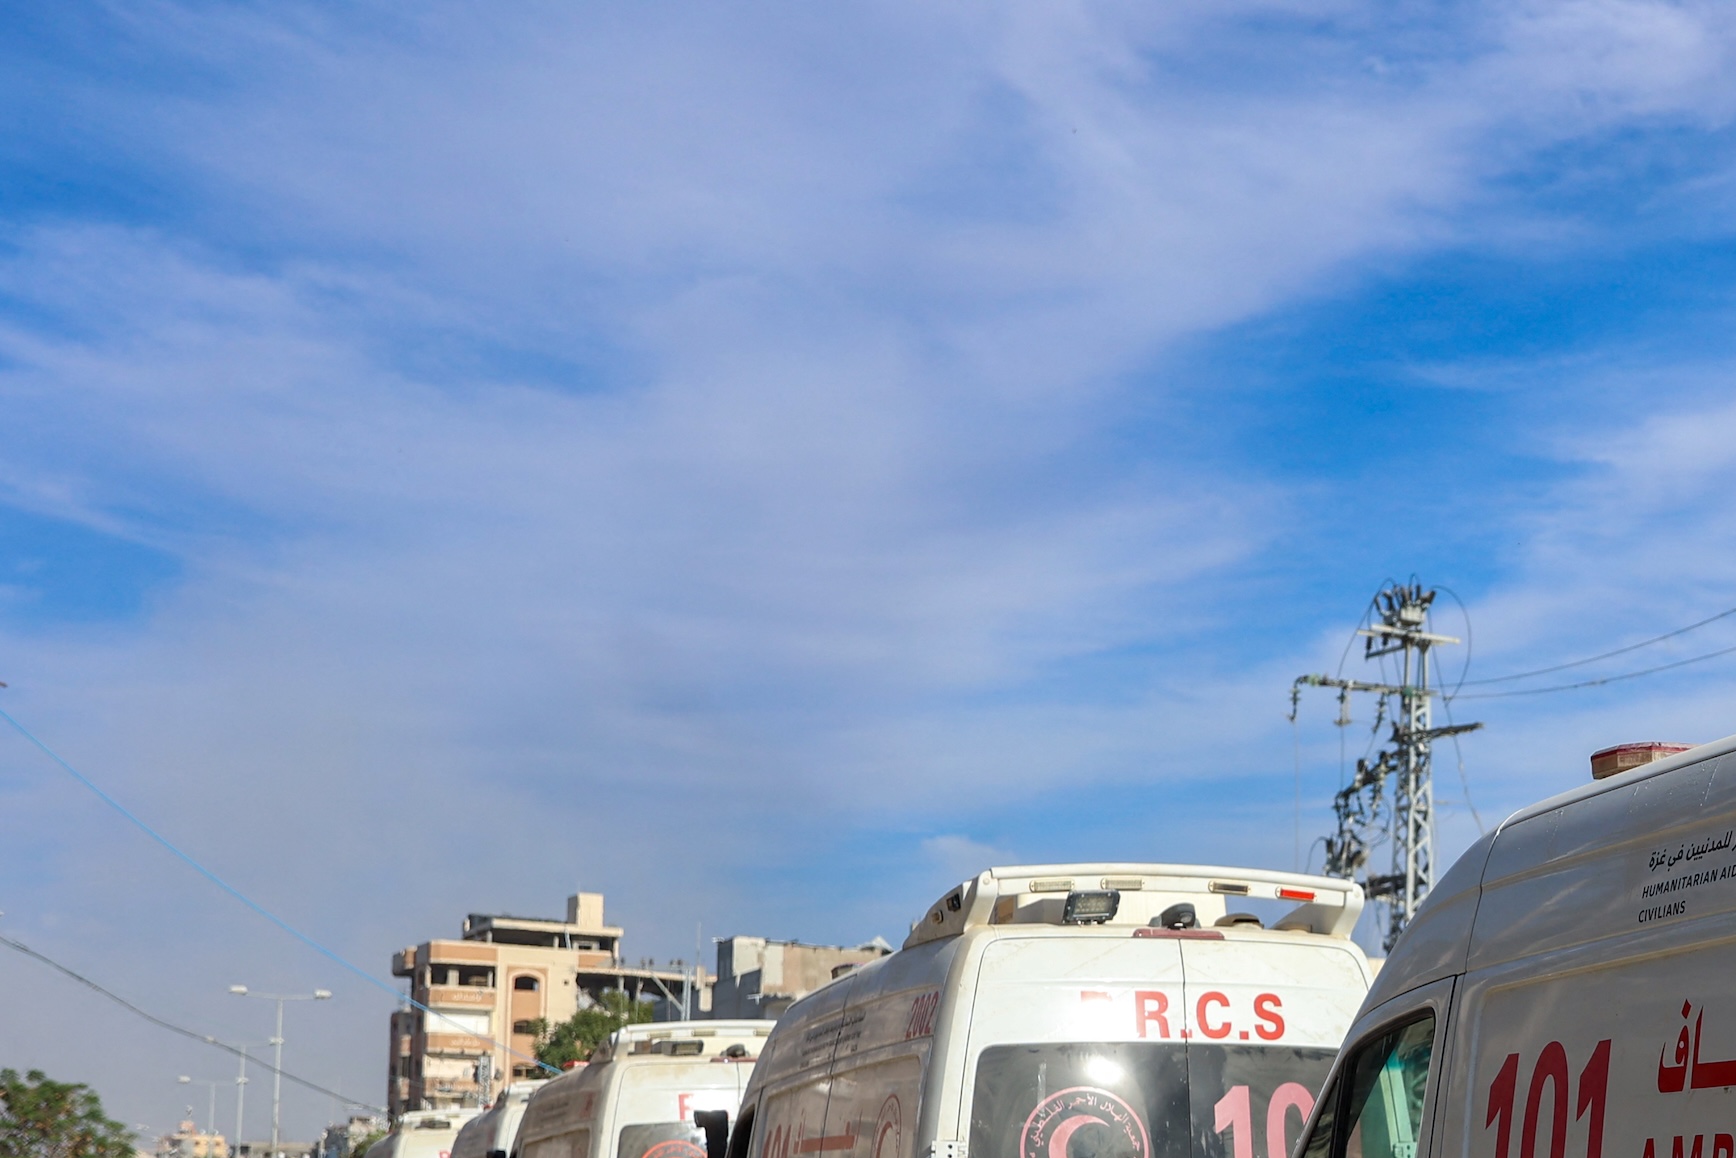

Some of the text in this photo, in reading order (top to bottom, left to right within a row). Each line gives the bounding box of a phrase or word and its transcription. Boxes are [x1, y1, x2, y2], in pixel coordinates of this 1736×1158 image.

[1648, 848, 1667, 872] غزة
[1685, 830, 1733, 861] للمدنيين
[1641, 868, 1718, 899] HUMANITARIAN
[1637, 900, 1686, 923] CIVILIANS
[905, 991, 939, 1039] 2002
[1081, 990, 1285, 1041] R.C.S
